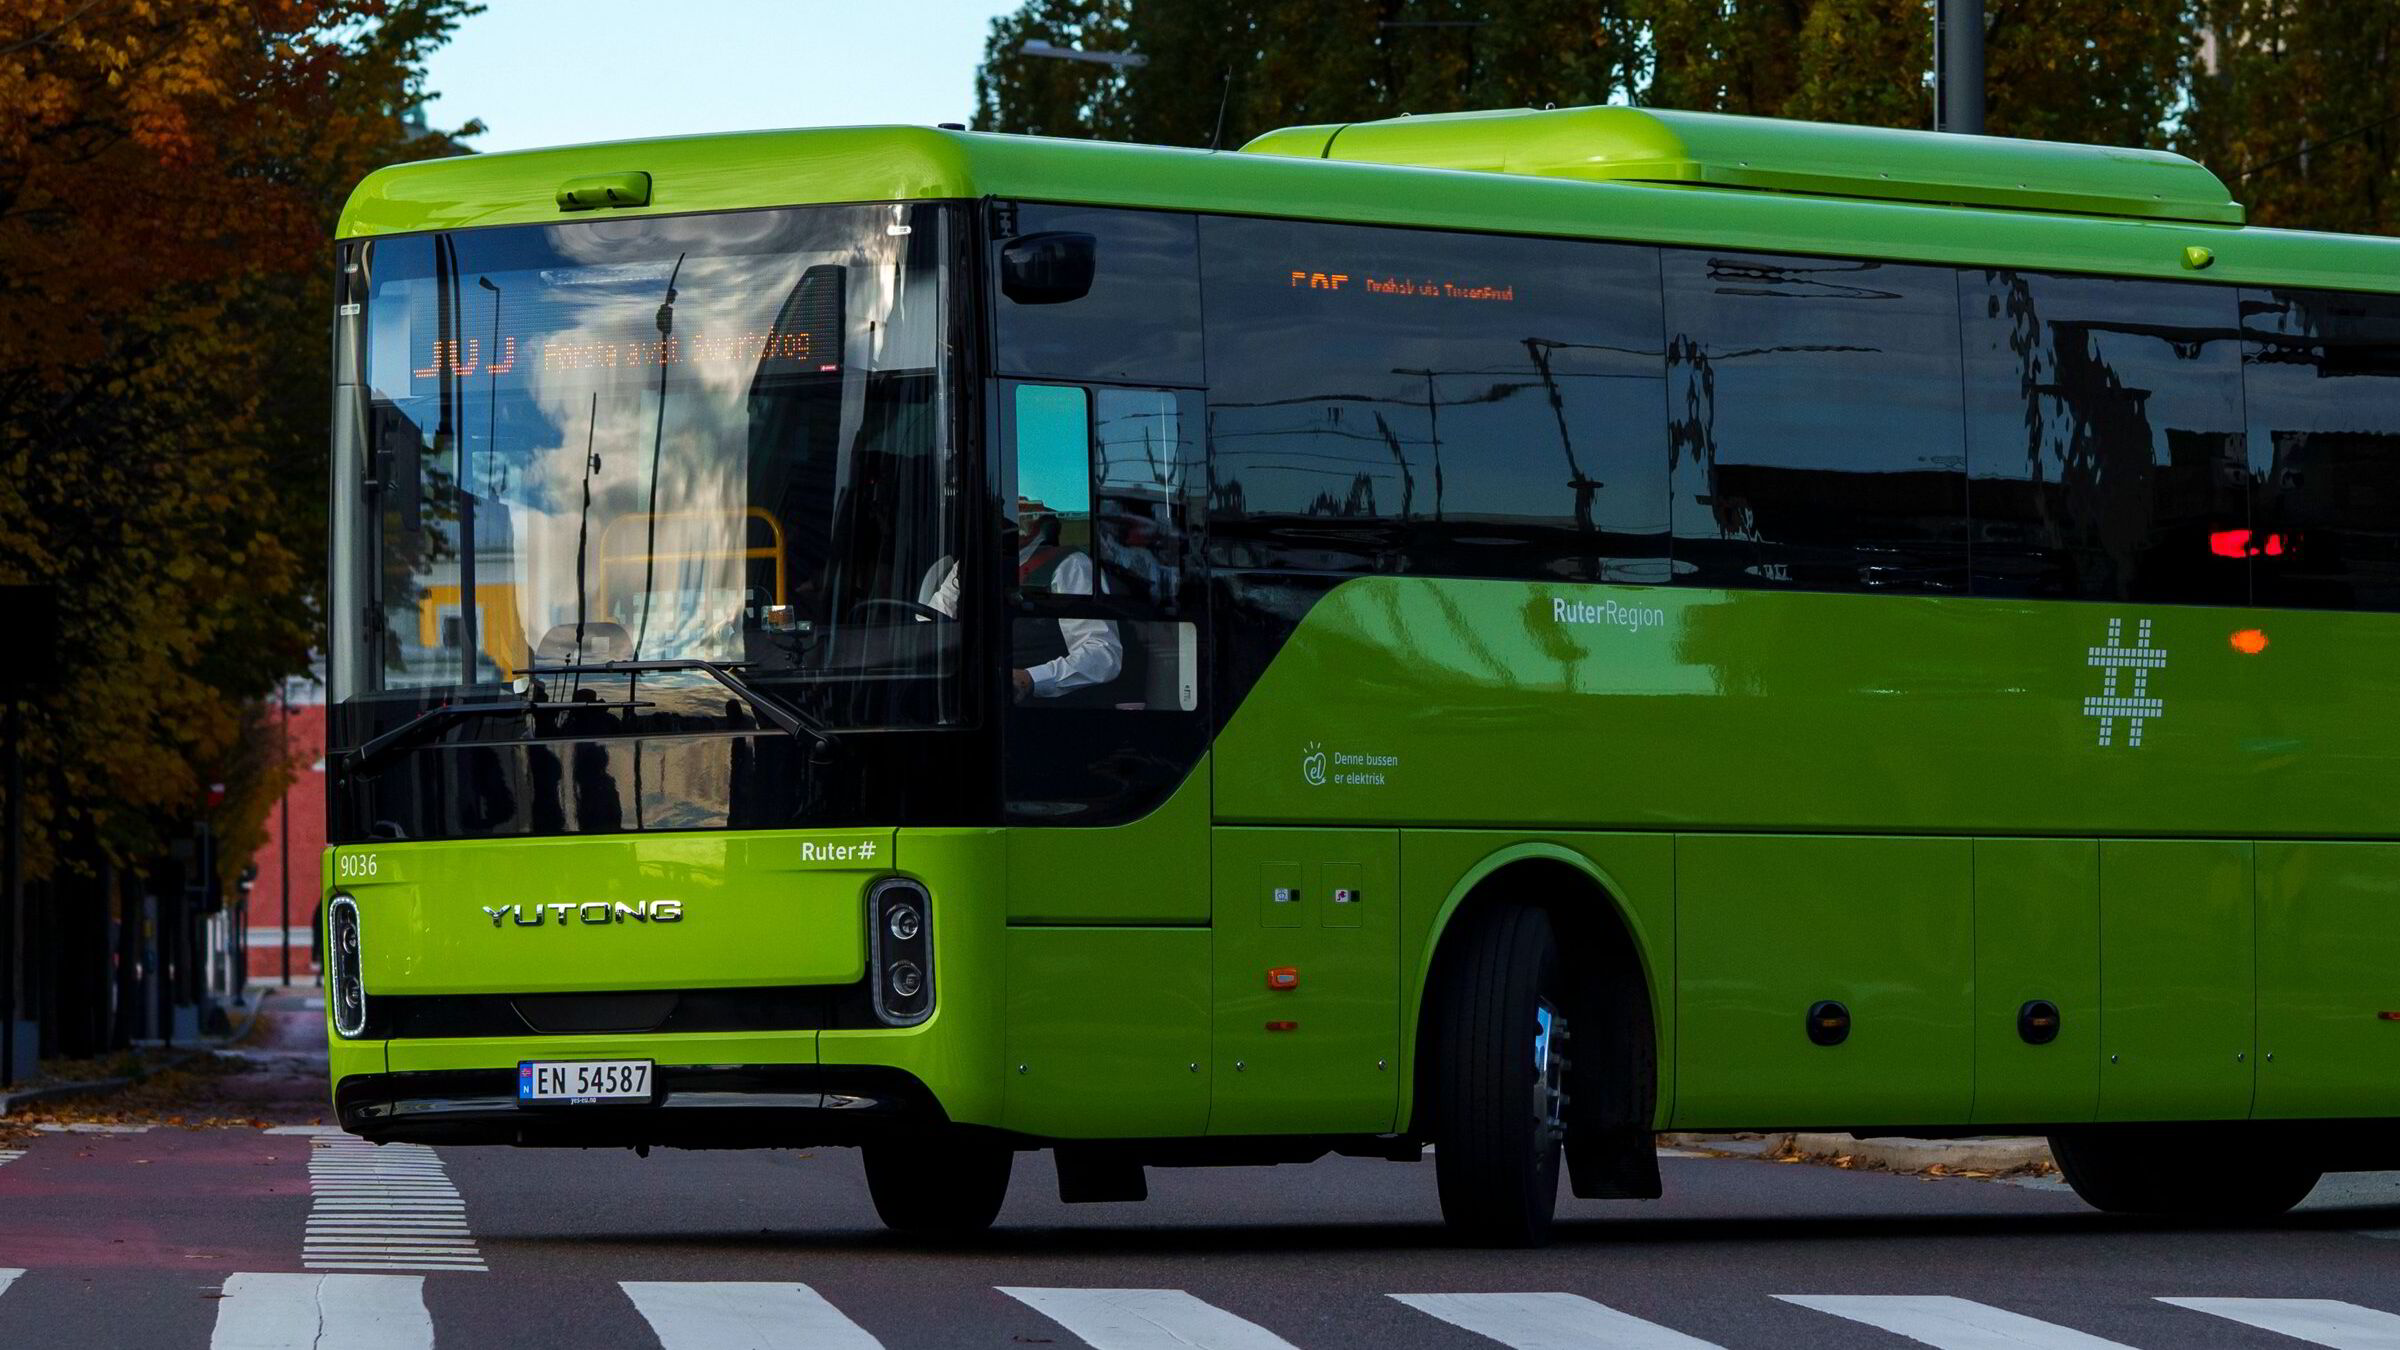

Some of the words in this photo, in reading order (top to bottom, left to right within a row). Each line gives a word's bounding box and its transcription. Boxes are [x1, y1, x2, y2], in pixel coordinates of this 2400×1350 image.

[1553, 597, 1664, 633] RuterRegion
[1334, 751, 1364, 766] Denne
[1366, 753, 1398, 767] bussen
[1334, 773, 1345, 784] er
[1346, 772, 1385, 785] elektrisk
[802, 840, 877, 861] Ruter#
[341, 853, 378, 877] 9036
[482, 900, 684, 928] YUTONG
[523, 1085, 530, 1094] N
[538, 1067, 566, 1095] EN
[577, 1065, 648, 1094] 54587
